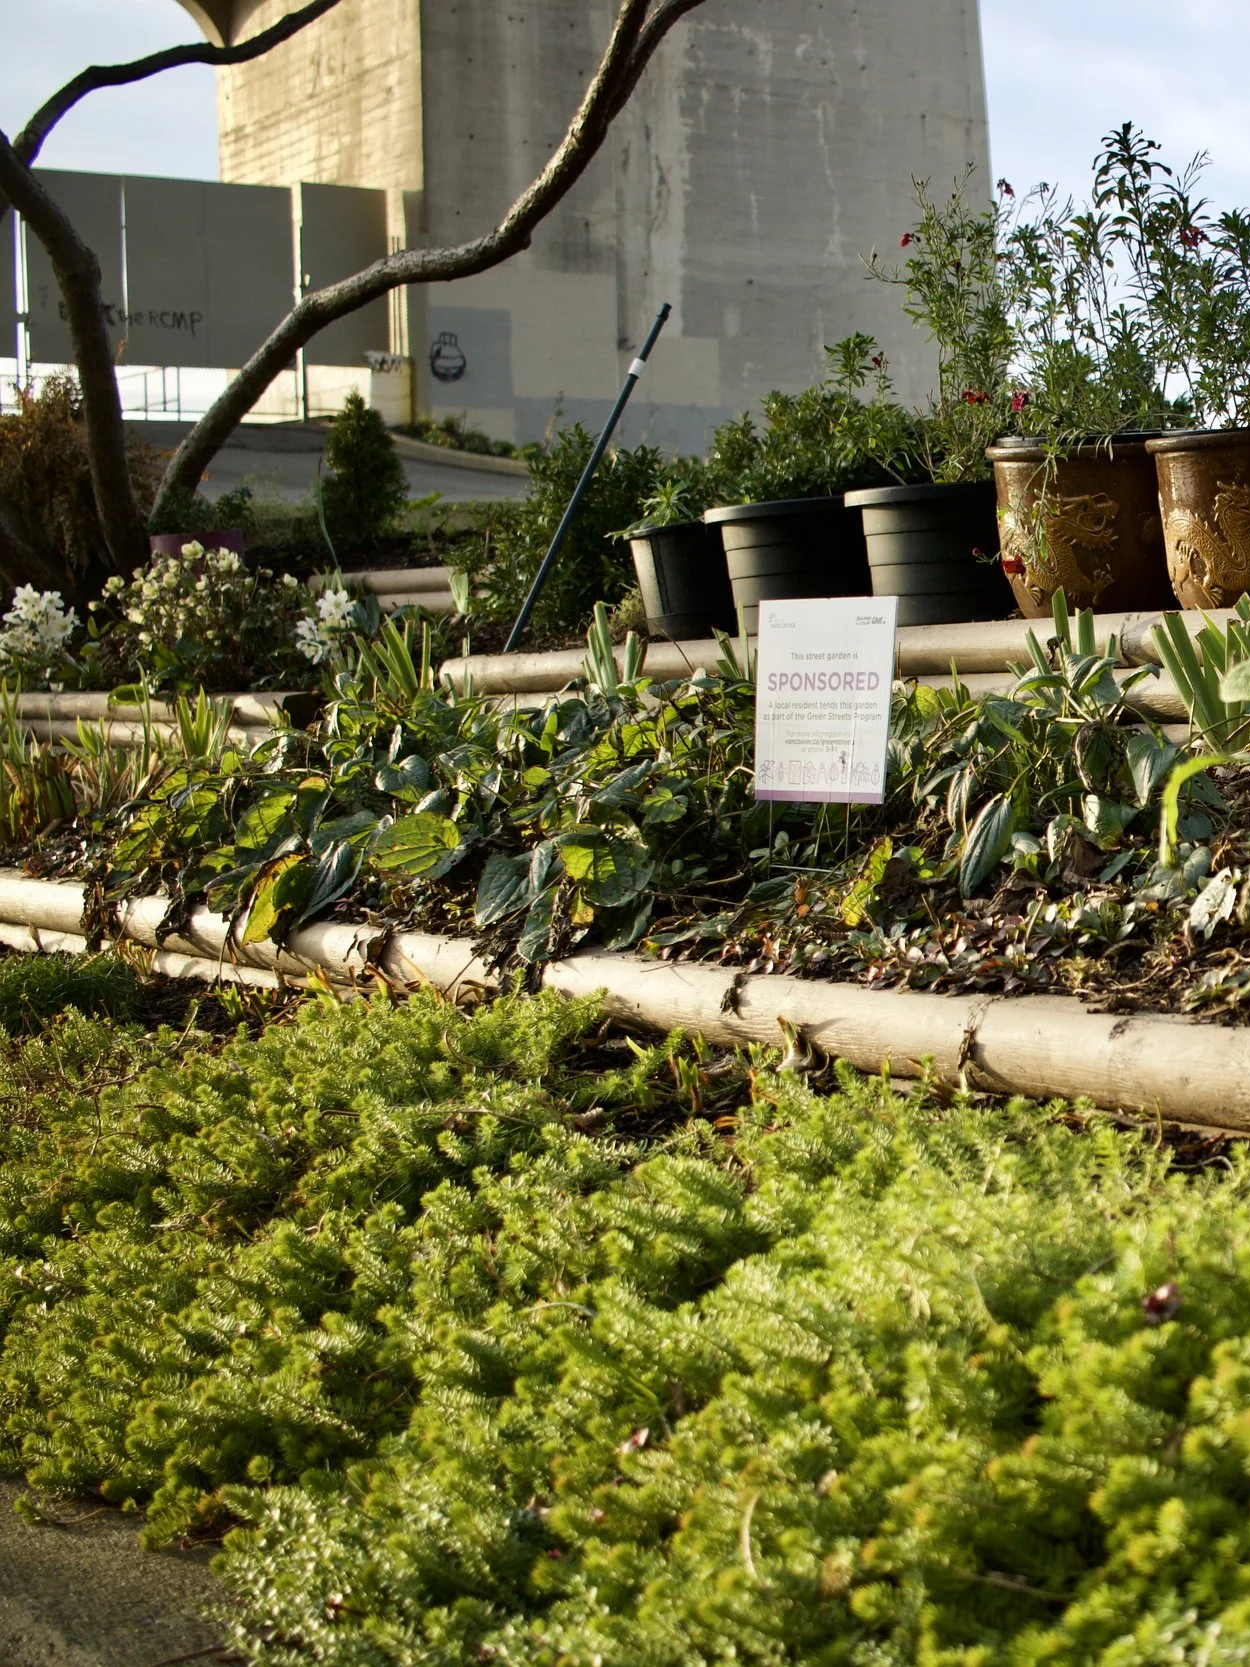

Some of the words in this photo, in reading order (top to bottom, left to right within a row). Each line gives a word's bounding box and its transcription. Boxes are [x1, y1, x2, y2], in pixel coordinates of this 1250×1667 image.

[148, 309, 203, 337] RCMP
[791, 652, 805, 660] This
[805, 652, 826, 660] street
[827, 651, 851, 662] garden
[852, 651, 859, 660] is
[767, 671, 880, 692] SPONSORED
[774, 701, 791, 710] local
[791, 701, 819, 710] resident
[819, 701, 838, 710] tends
[839, 701, 852, 710] this
[853, 701, 878, 711] garden
[763, 713, 771, 721] as
[772, 712, 786, 722] part
[786, 711, 794, 721] of
[794, 712, 806, 721] the
[806, 712, 827, 721] Green
[828, 712, 852, 721] Streets
[853, 712, 882, 722] Program
